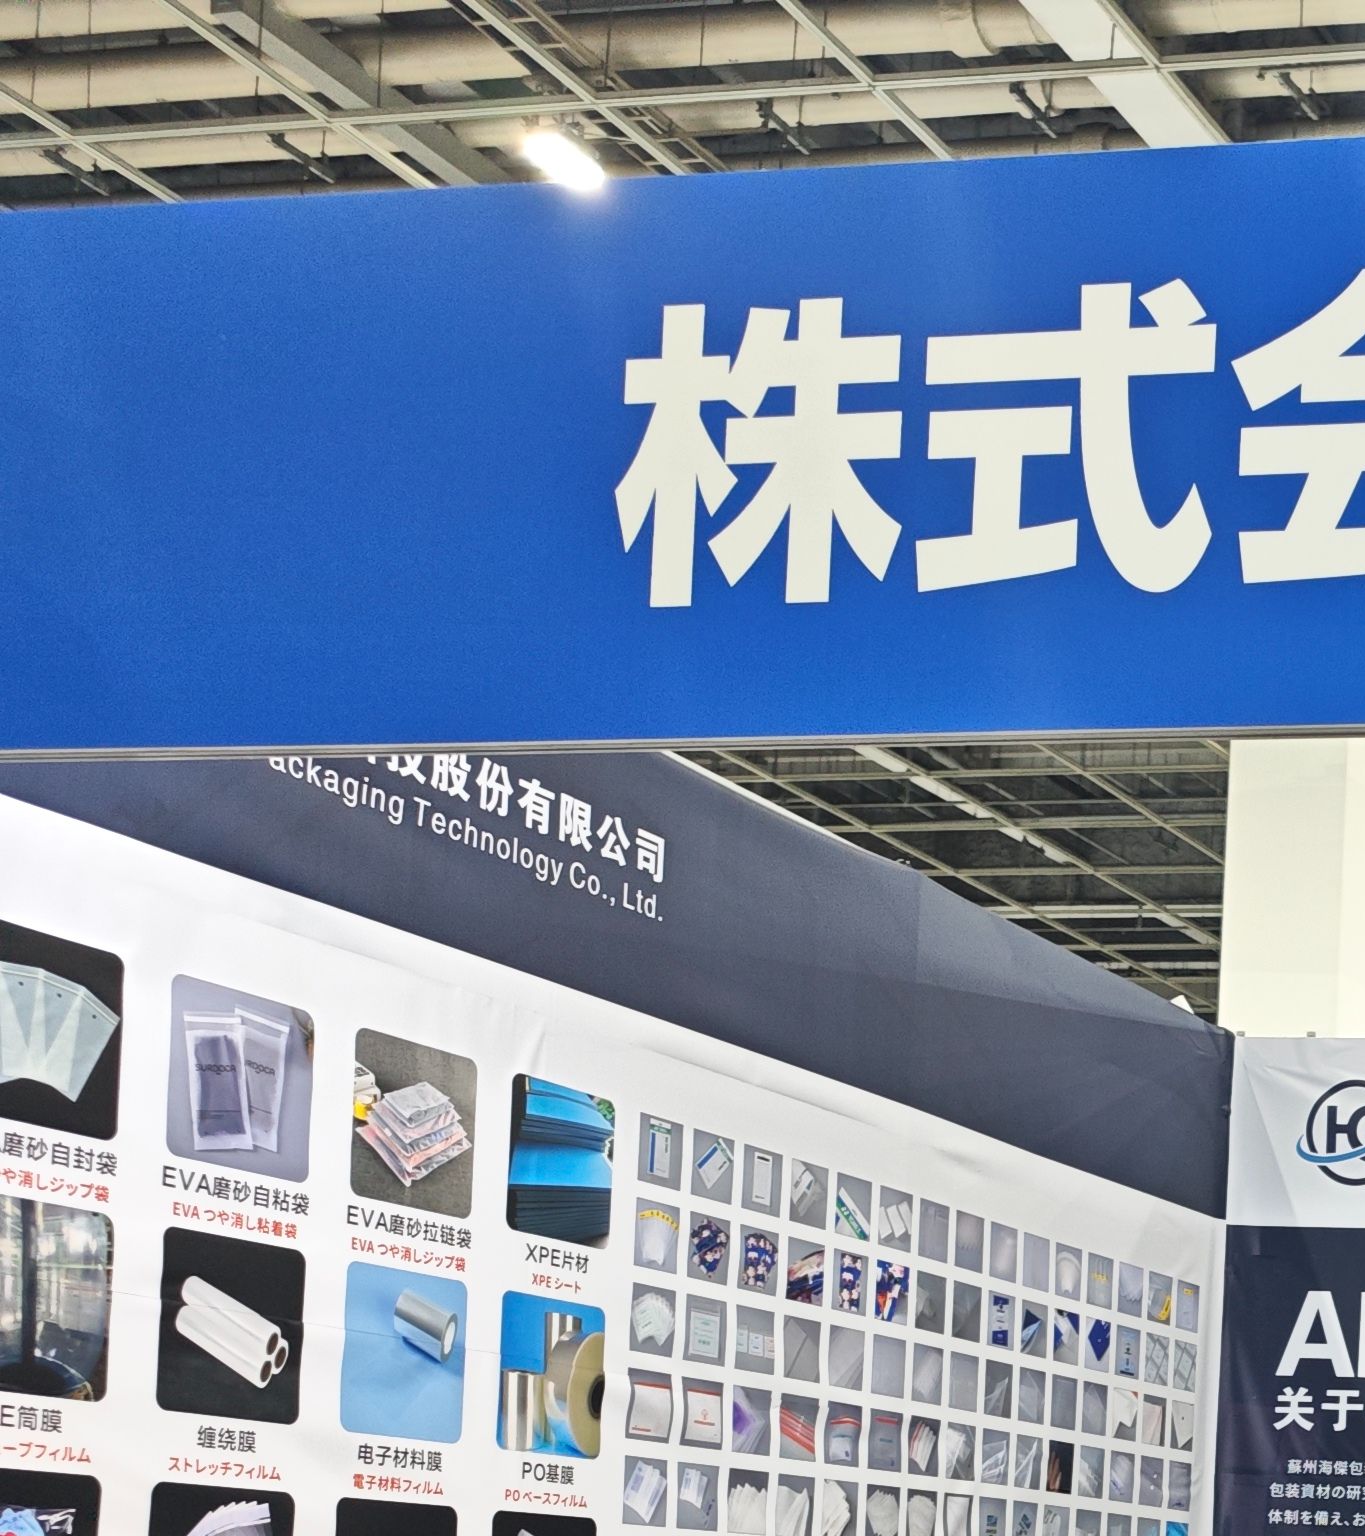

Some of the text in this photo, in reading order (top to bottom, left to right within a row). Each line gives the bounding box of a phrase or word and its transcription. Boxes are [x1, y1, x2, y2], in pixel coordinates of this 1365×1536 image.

[366, 755, 665, 884] 技股份有限公司
[413, 796, 564, 886] Technology
[569, 860, 615, 906] Co.,
[622, 881, 664, 922] Ltd.
[0, 1131, 118, 1177] 磨砂自封袋
[0, 1167, 109, 1203] や消しジップ袋
[161, 1165, 310, 1216] EVA磨砂自粘袋
[172, 1201, 297, 1239] EVA つや消し粘着袋
[346, 1205, 472, 1249] EVA磨砂拉链袋
[351, 1237, 467, 1272] EVA つや消しジップ袋
[525, 1243, 590, 1274] XPE片材
[531, 1273, 582, 1294] XPE シート
[197, 1425, 257, 1453] 缠绕膜
[168, 1456, 281, 1481] ストレッチフィルム
[357, 1443, 443, 1472] 电子材料膜
[522, 1462, 575, 1486] PO基膜
[352, 1474, 444, 1496] 電子材料フィルム
[504, 1489, 588, 1509] PO ベースフィルム
